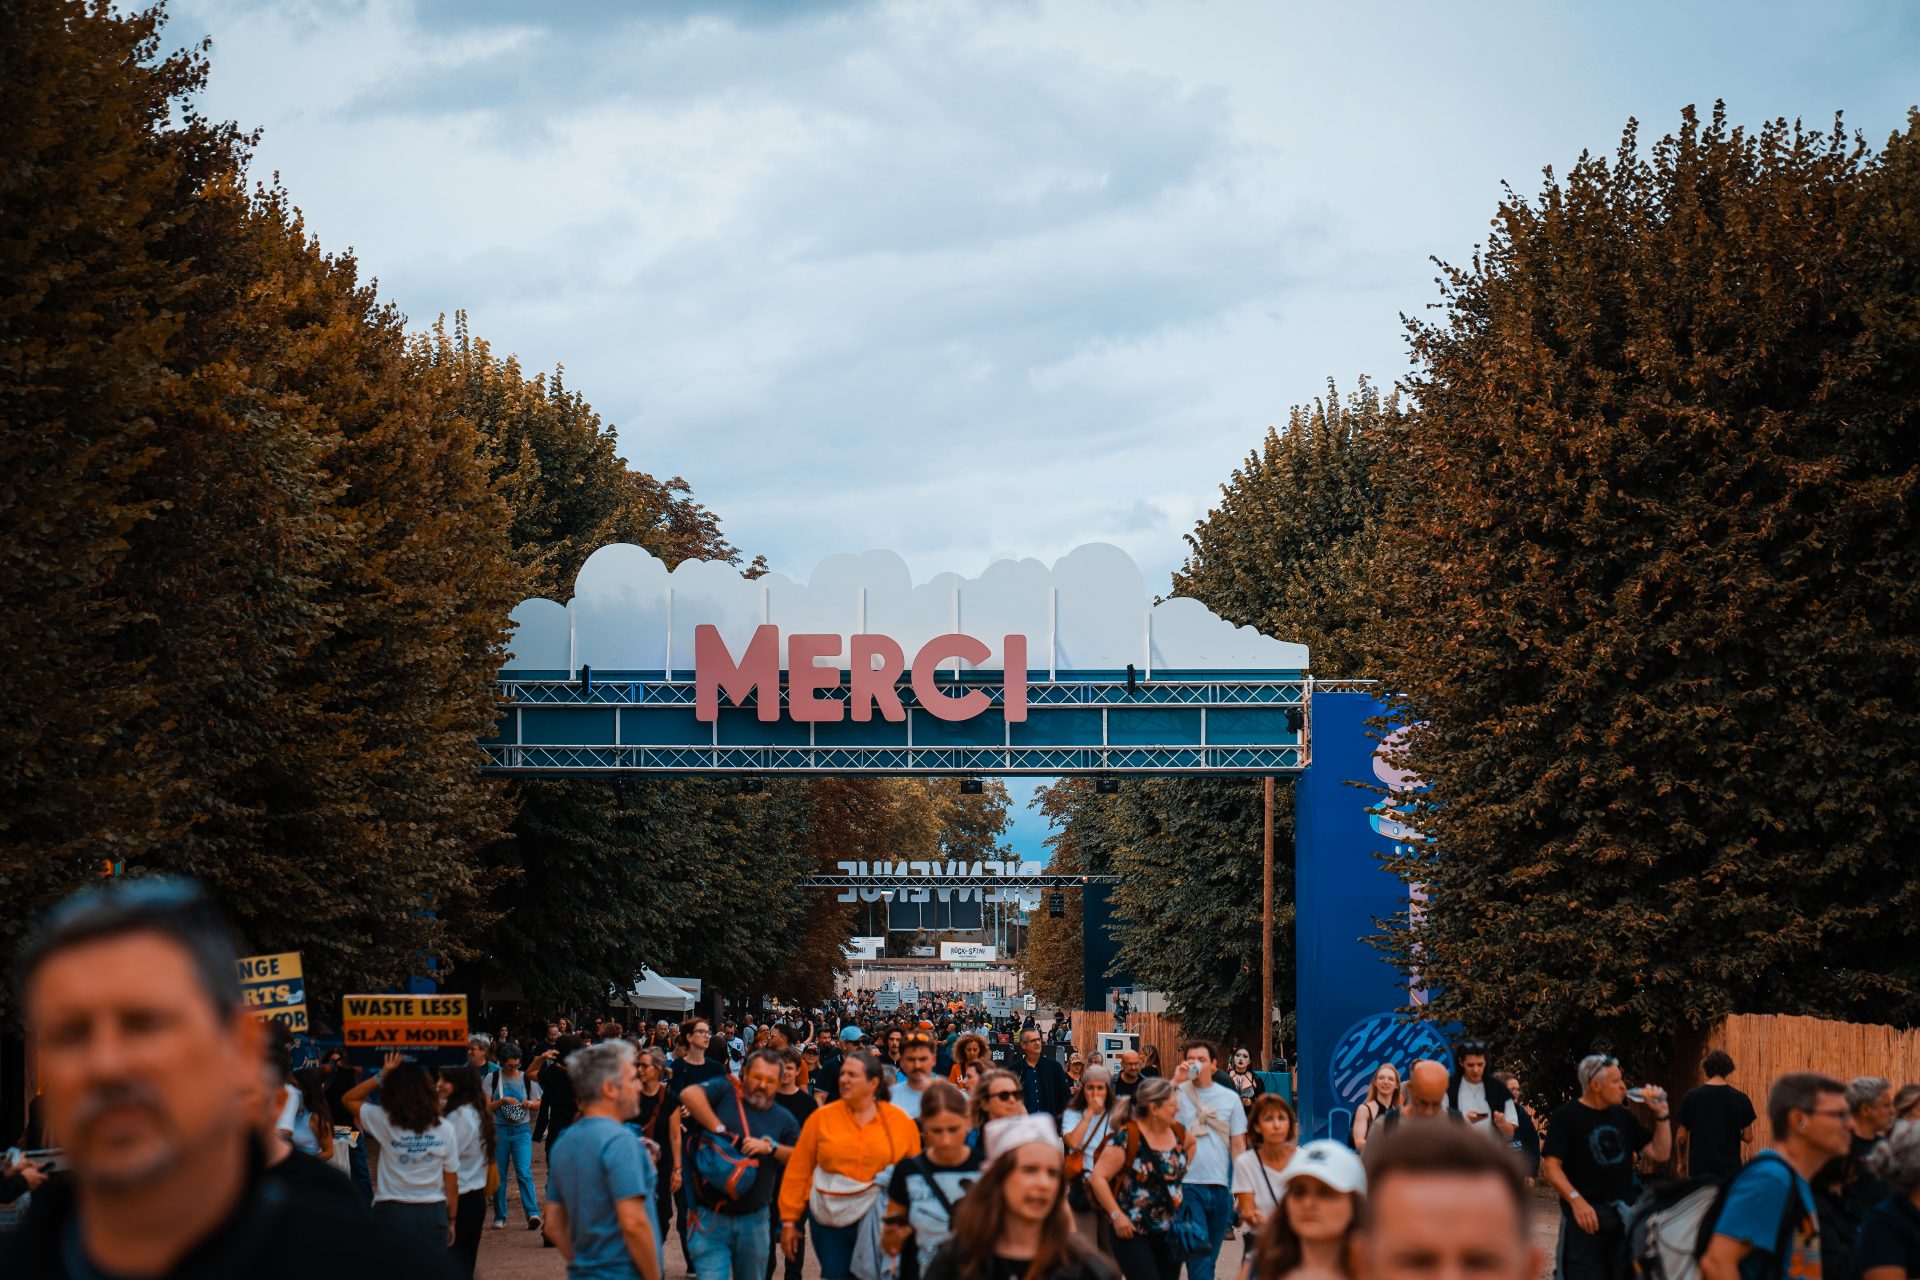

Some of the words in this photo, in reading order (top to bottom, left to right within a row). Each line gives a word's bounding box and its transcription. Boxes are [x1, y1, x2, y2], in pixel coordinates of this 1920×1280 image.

[695, 624, 1027, 722] MERCI
[239, 958, 280, 979] NGE
[242, 984, 289, 1006] RTS
[349, 1000, 413, 1016] WASTE
[421, 1000, 462, 1016] LESS
[347, 1029, 399, 1042] SLAY
[405, 1029, 465, 1043] MORE
